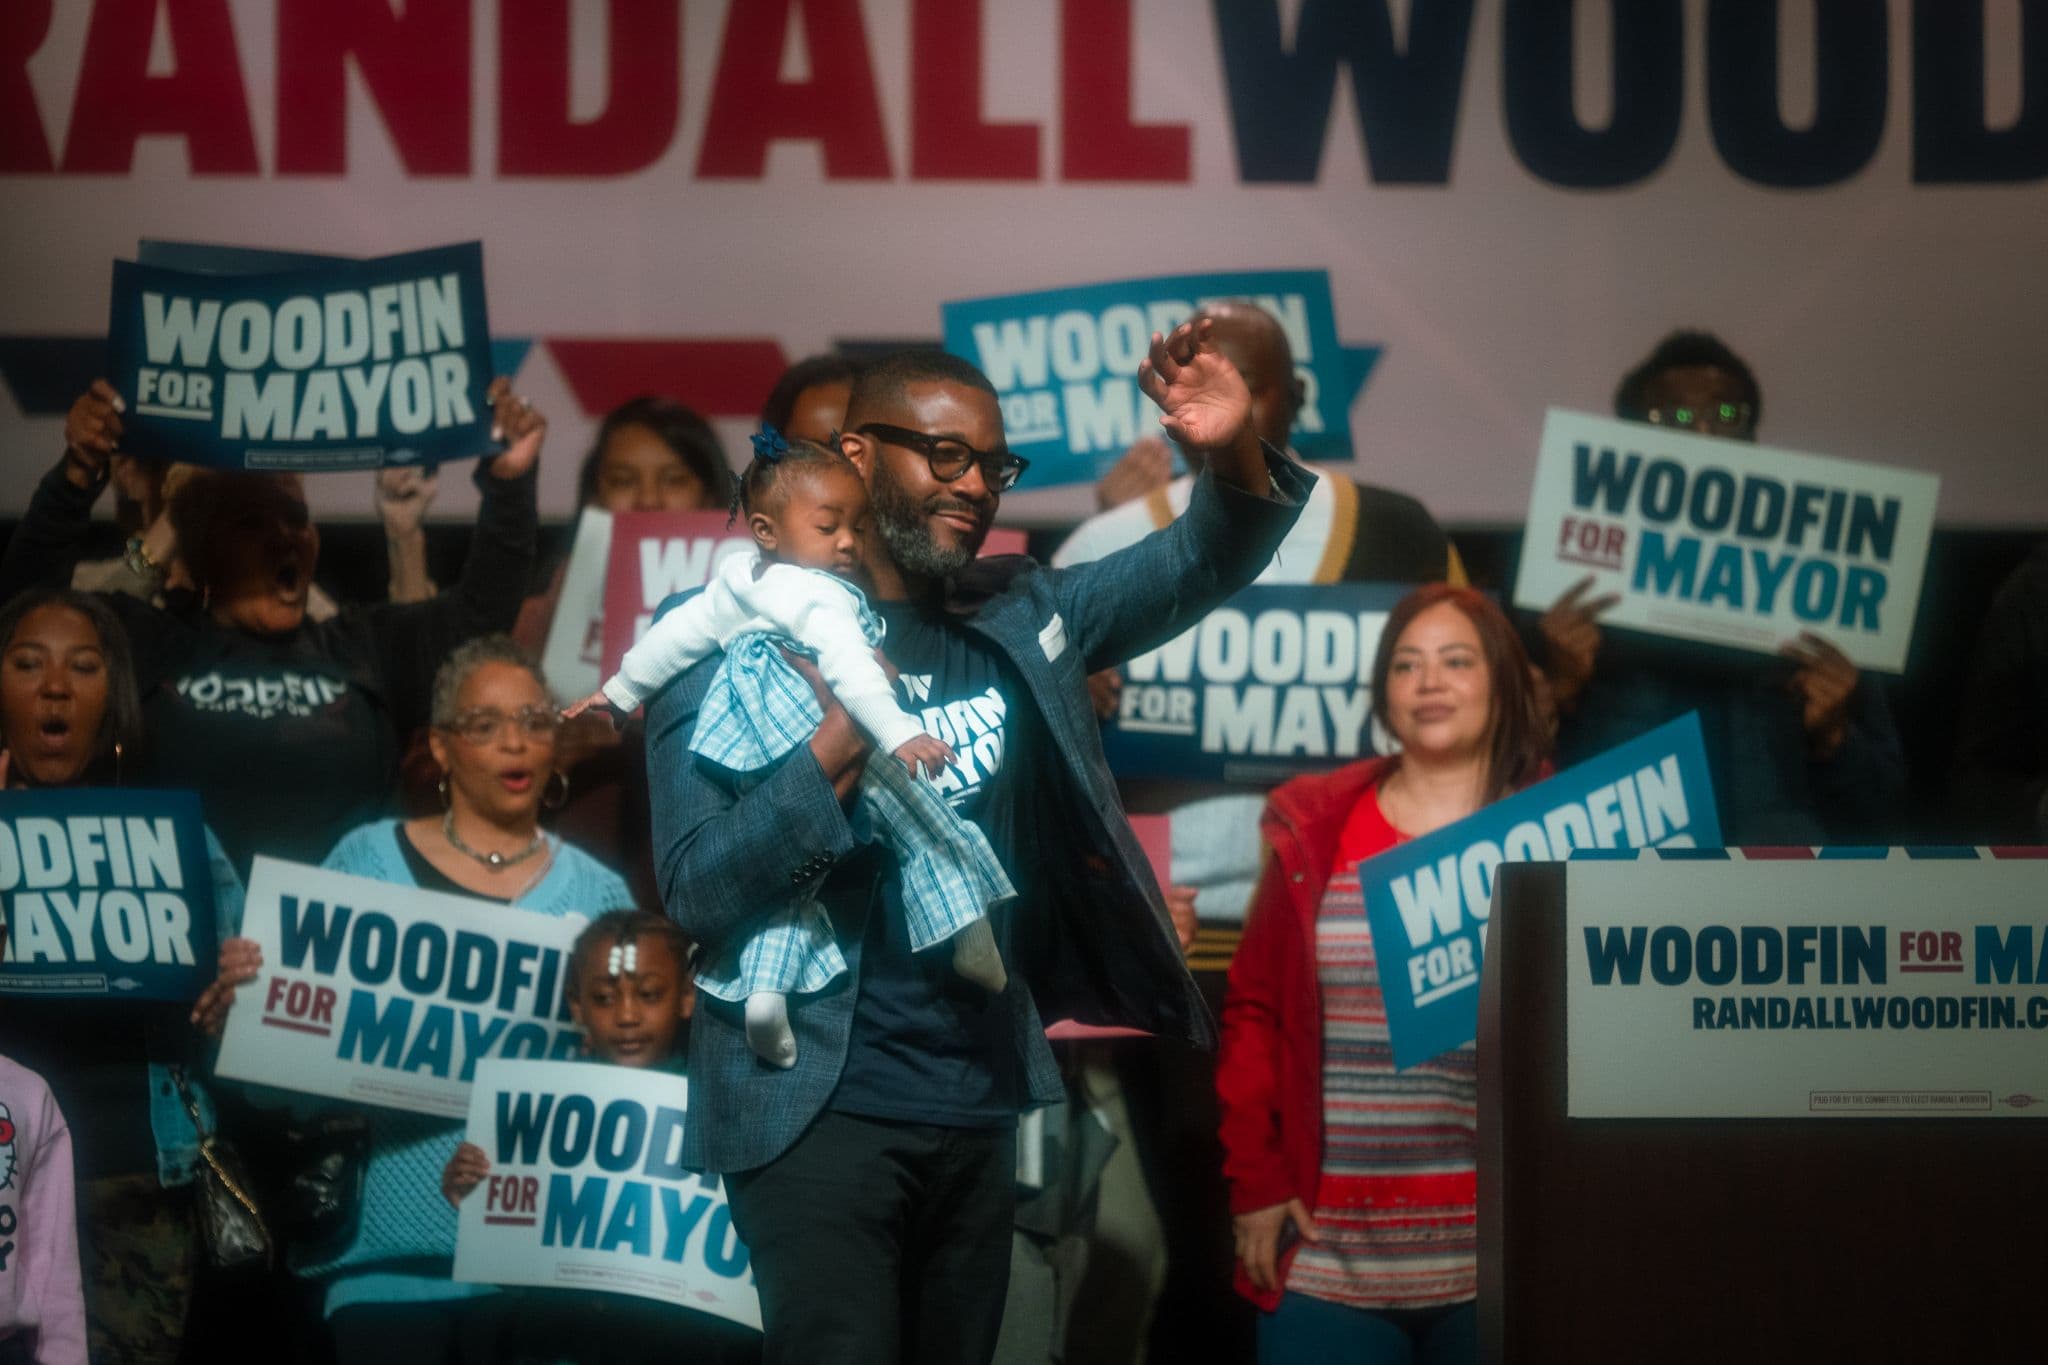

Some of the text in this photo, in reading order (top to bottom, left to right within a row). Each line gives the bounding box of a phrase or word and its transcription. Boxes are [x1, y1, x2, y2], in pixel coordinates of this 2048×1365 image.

[0, 0, 1192, 182] ANDALL
[141, 272, 466, 370] WOODFIN
[136, 352, 476, 442] FOR MAYOR
[1573, 442, 1902, 562] WOODFIN
[1558, 517, 1627, 558] FOR
[1631, 529, 1888, 633] MAYOR
[1119, 684, 1403, 757] FOR MAY
[0, 890, 196, 967] AYOR
[280, 894, 571, 1023] WOODFI
[1408, 936, 1477, 996] FOR
[1583, 925, 1887, 986] WOODFIN
[1900, 931, 1962, 962] FOR
[264, 977, 337, 1024] FOR
[495, 1090, 721, 1191] WOOD
[485, 1175, 539, 1213] FOR
[541, 1173, 757, 1287] MAYO
